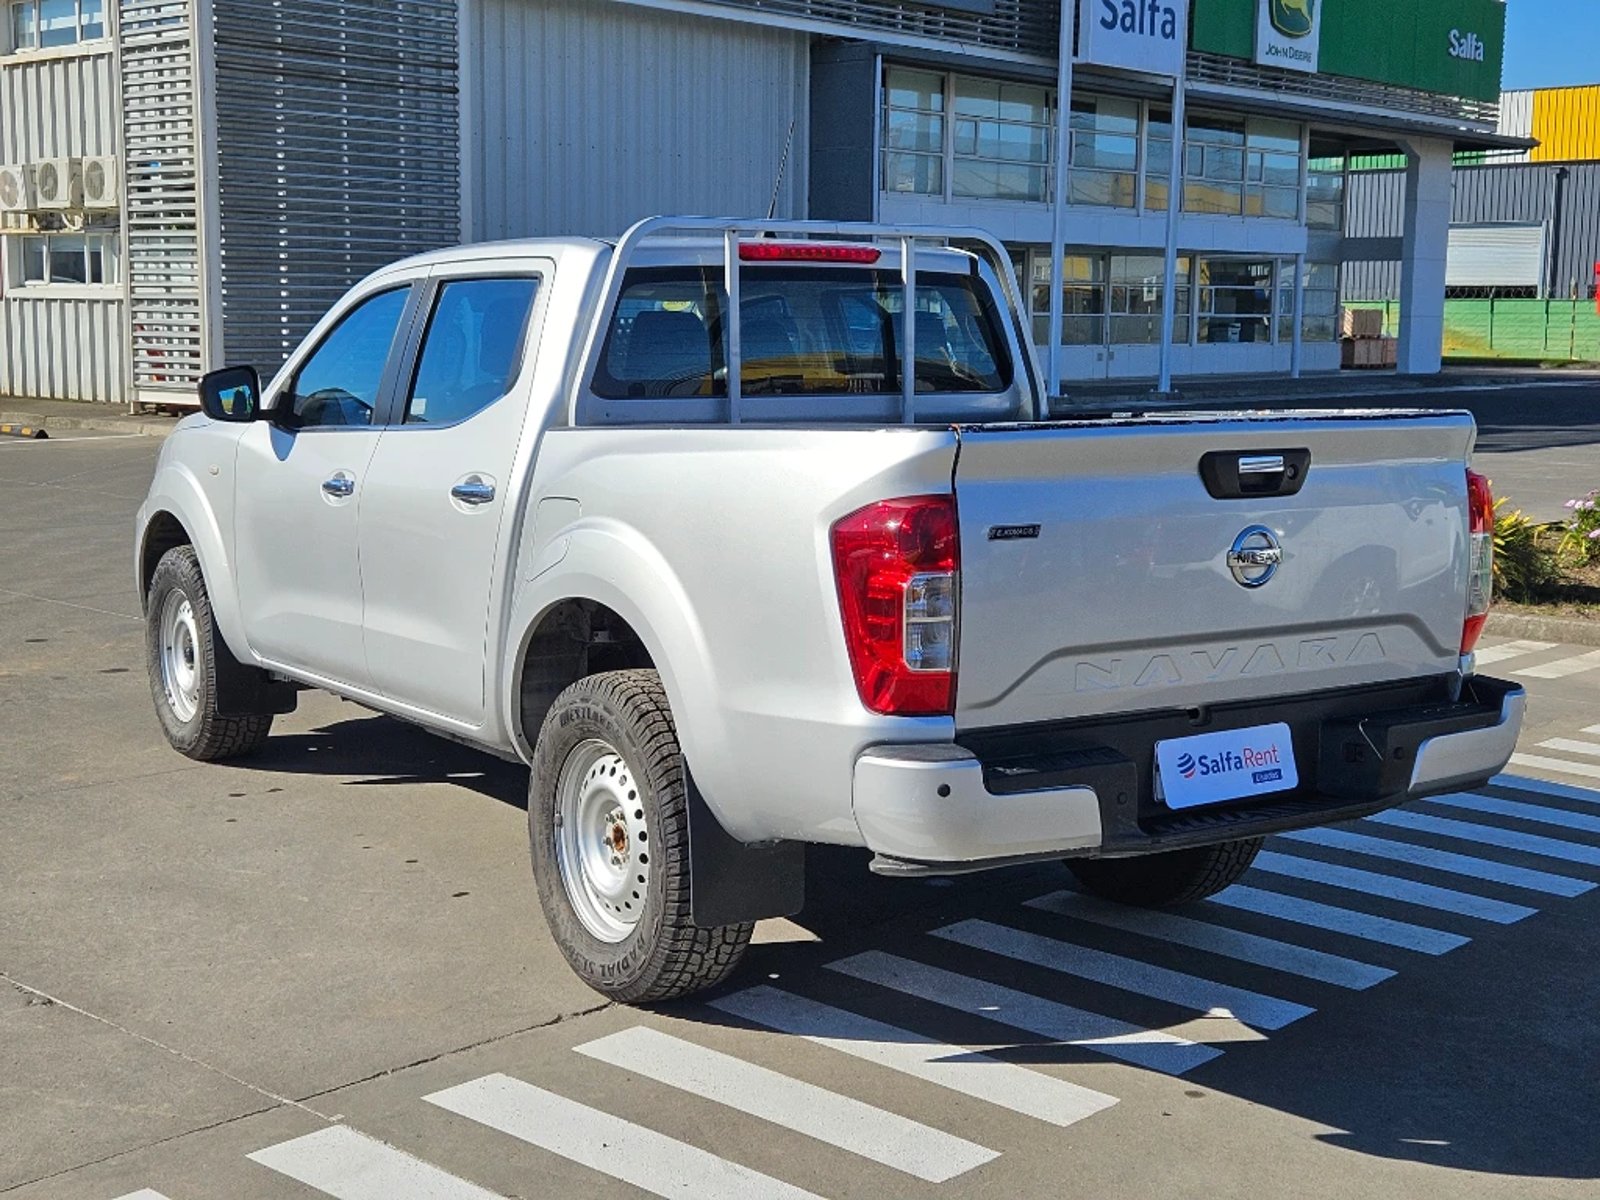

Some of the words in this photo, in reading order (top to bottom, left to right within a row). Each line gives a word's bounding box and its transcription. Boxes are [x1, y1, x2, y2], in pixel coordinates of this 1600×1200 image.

[1100, 0, 1175, 40] Salfa
[1265, 43, 1288, 58] JOHN
[1289, 46, 1312, 63] DEERE
[1448, 28, 1484, 62] Salfa
[1236, 551, 1281, 564] NISSAN
[1075, 633, 1385, 691] NAVARA
